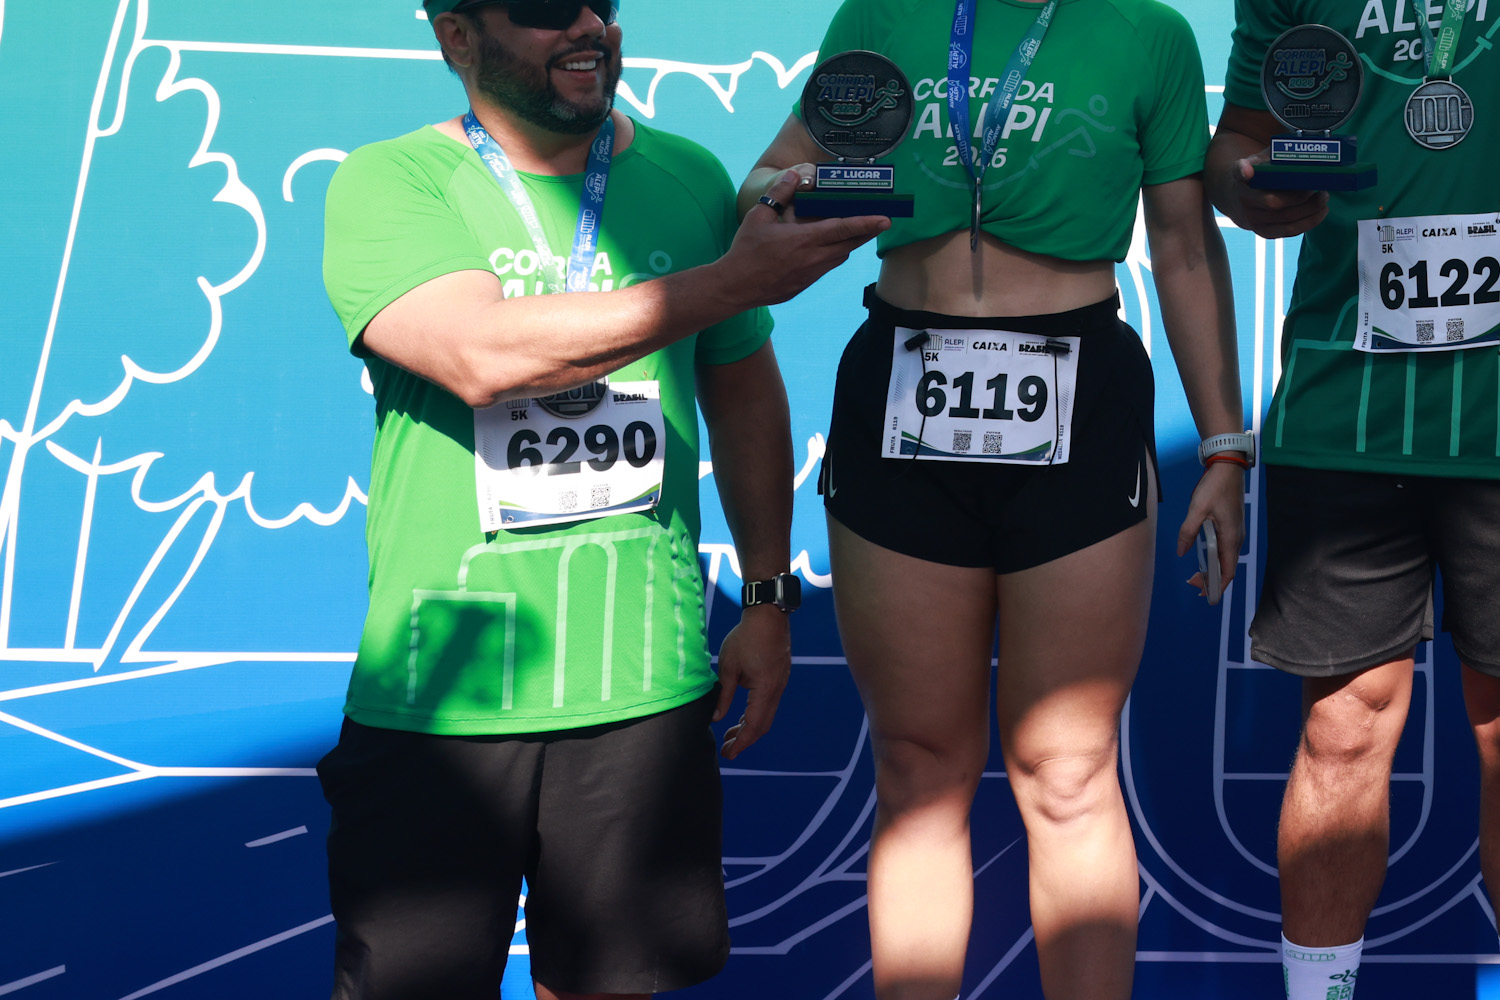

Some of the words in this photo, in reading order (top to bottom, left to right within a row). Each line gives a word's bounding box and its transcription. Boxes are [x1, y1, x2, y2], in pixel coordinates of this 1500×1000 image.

[1026, 38, 1036, 57] ALEPI
[1273, 49, 1325, 61] CORRIDA
[1393, 37, 1424, 61] 20
[1274, 60, 1325, 76] ALEPI
[817, 74, 875, 86] CORRIDA
[1288, 78, 1315, 88] 2026
[818, 86, 875, 102] ALEPI
[913, 77, 1054, 103] CORRDA
[832, 104, 862, 114] 2026
[1002, 93, 1011, 109] ALEPI
[913, 103, 1052, 142] API
[1295, 144, 1328, 152] LUGAR
[594, 173, 602, 193] ALEPI
[1422, 227, 1457, 237] CAIXA
[1467, 225, 1496, 234] BRASIL
[1382, 244, 1394, 253] 5K
[488, 248, 612, 279] CORA
[1379, 256, 1500, 310] 6122
[944, 338, 964, 346] ALEPI
[972, 342, 1007, 351] CAIXA
[924, 352, 939, 361] 5K
[613, 394, 648, 402] BRASIL
[916, 370, 1048, 422] 6119
[511, 410, 528, 421] 5K
[507, 421, 657, 477] 6290
